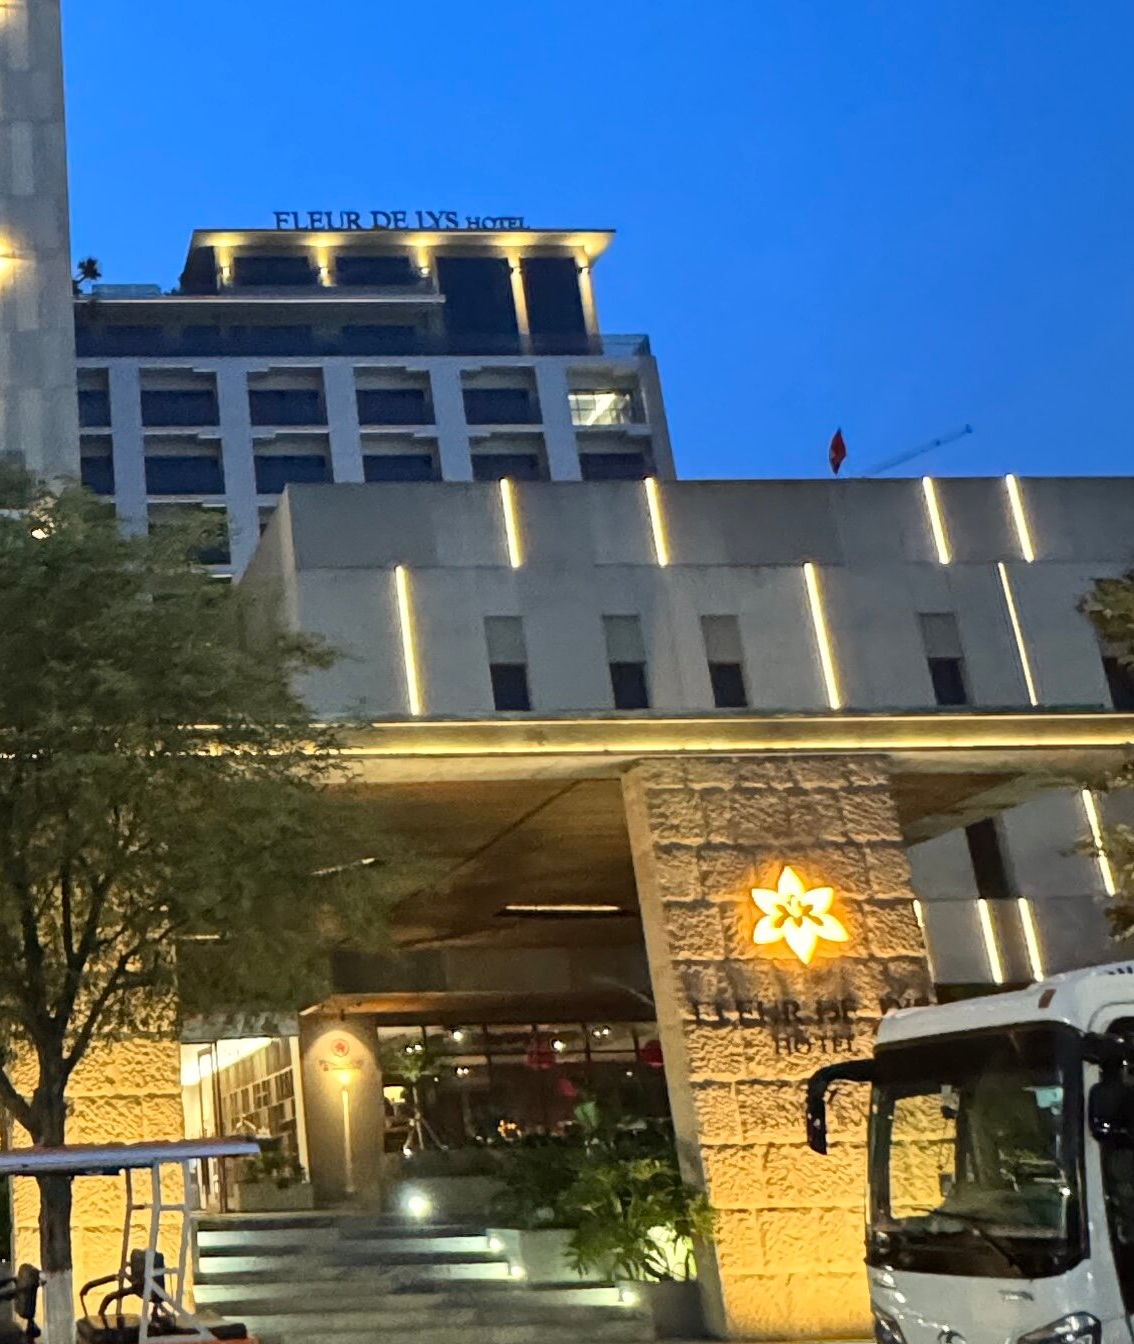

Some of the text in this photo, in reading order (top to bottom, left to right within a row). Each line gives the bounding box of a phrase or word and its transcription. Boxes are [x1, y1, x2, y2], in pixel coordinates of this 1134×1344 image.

[273, 210, 530, 229] FLEUR DE LYS HOTEL
[775, 1035, 854, 1054] HOTEL
